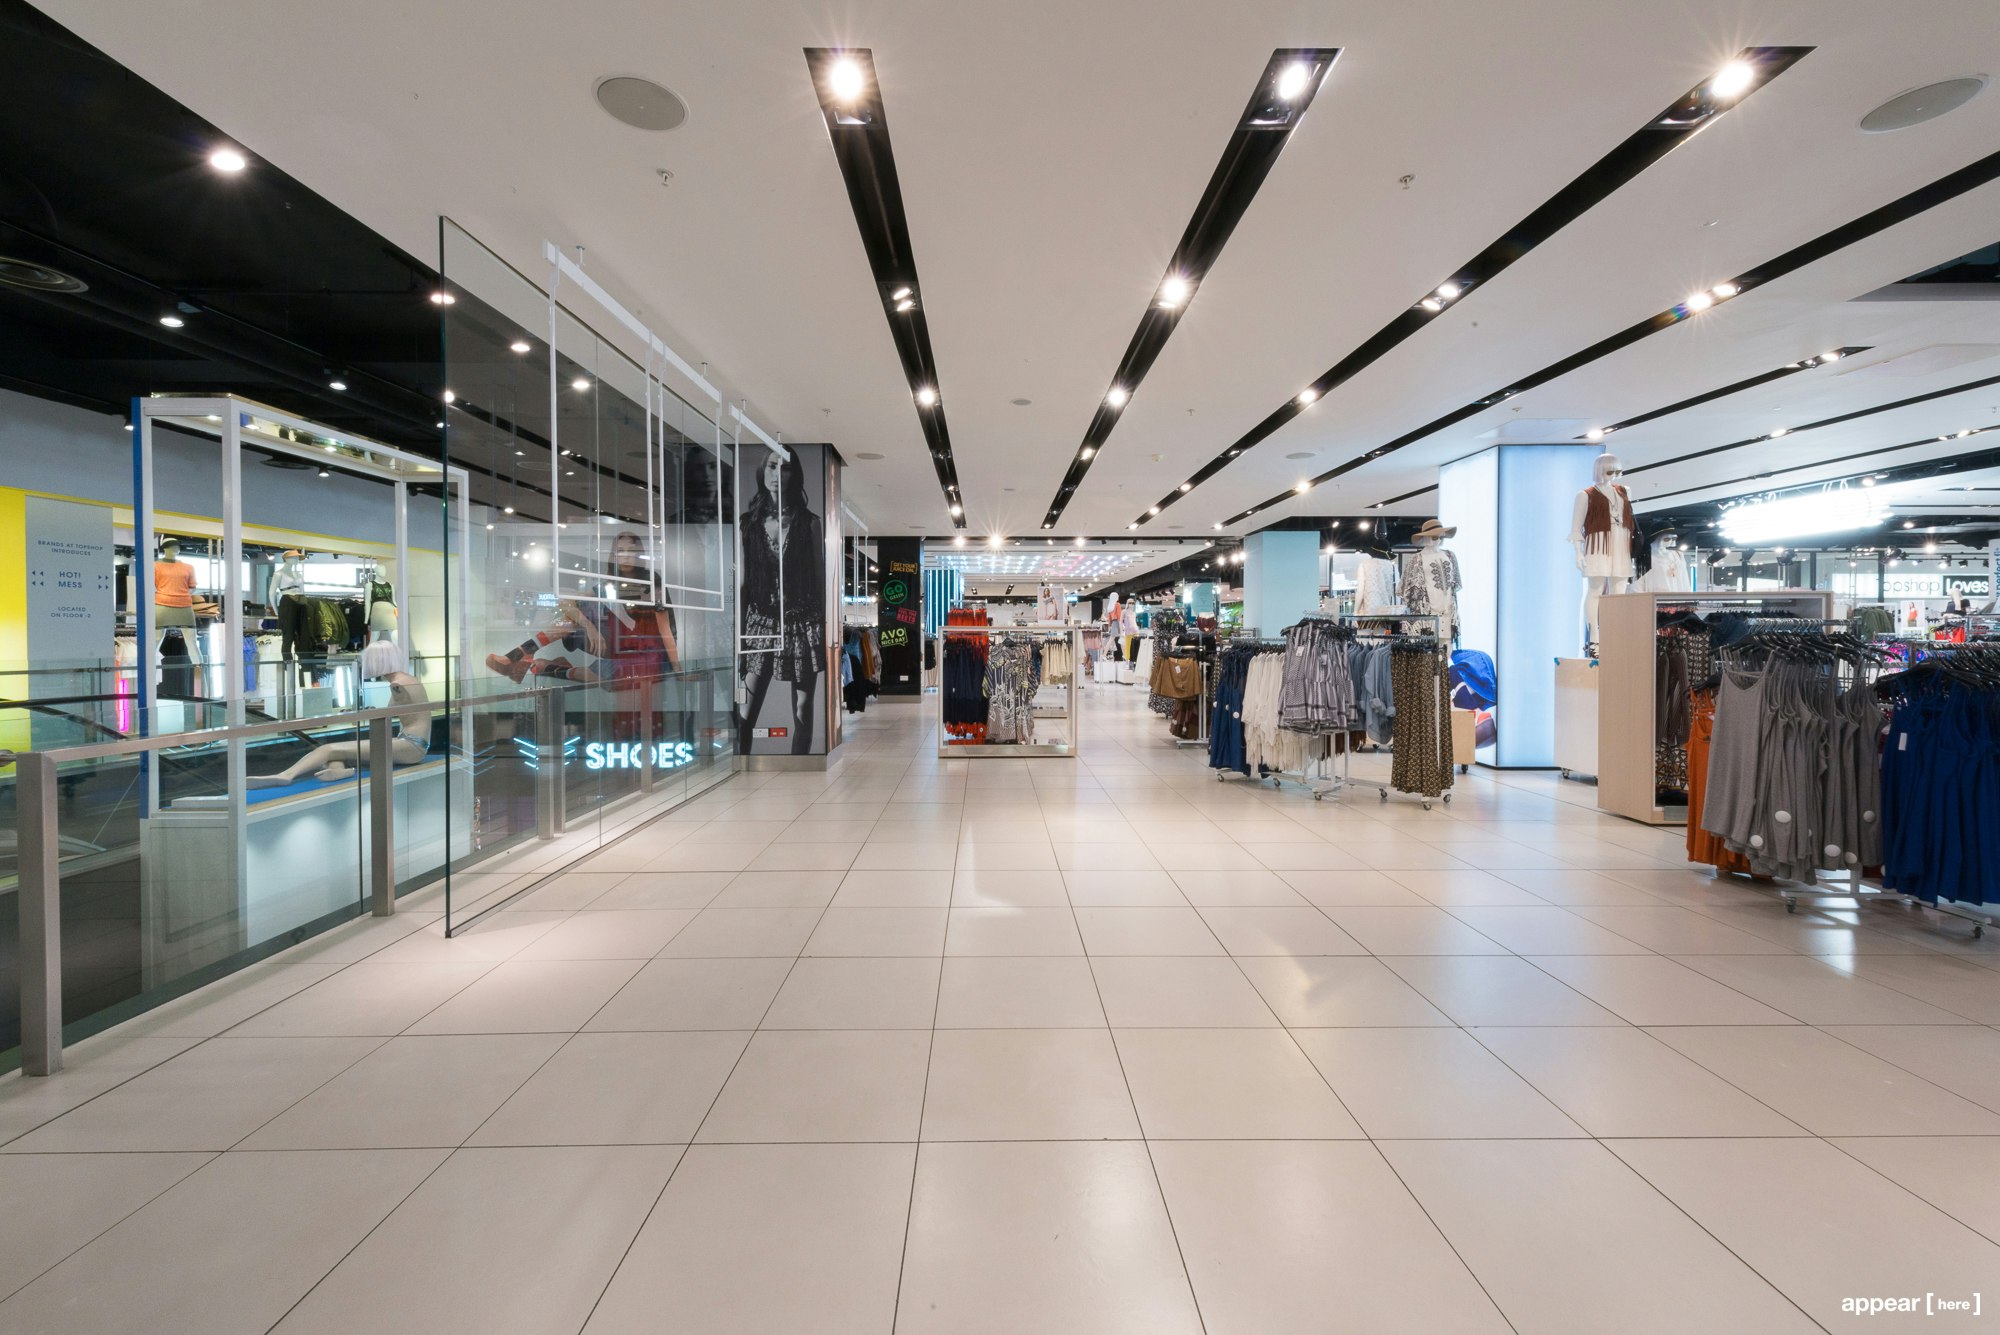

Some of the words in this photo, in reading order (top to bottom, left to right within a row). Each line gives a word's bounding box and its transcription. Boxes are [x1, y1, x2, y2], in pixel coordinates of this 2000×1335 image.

[37, 540, 64, 548] BRANDS
[76, 543, 103, 551] TOPSHOP
[51, 548, 91, 556] INTRODUCES
[58, 581, 82, 589] MESS
[886, 584, 903, 596] GO
[1874, 578, 1940, 595] opshop
[1945, 578, 1988, 596] Loves
[881, 628, 905, 640] AVO
[585, 742, 694, 769] SHOES
